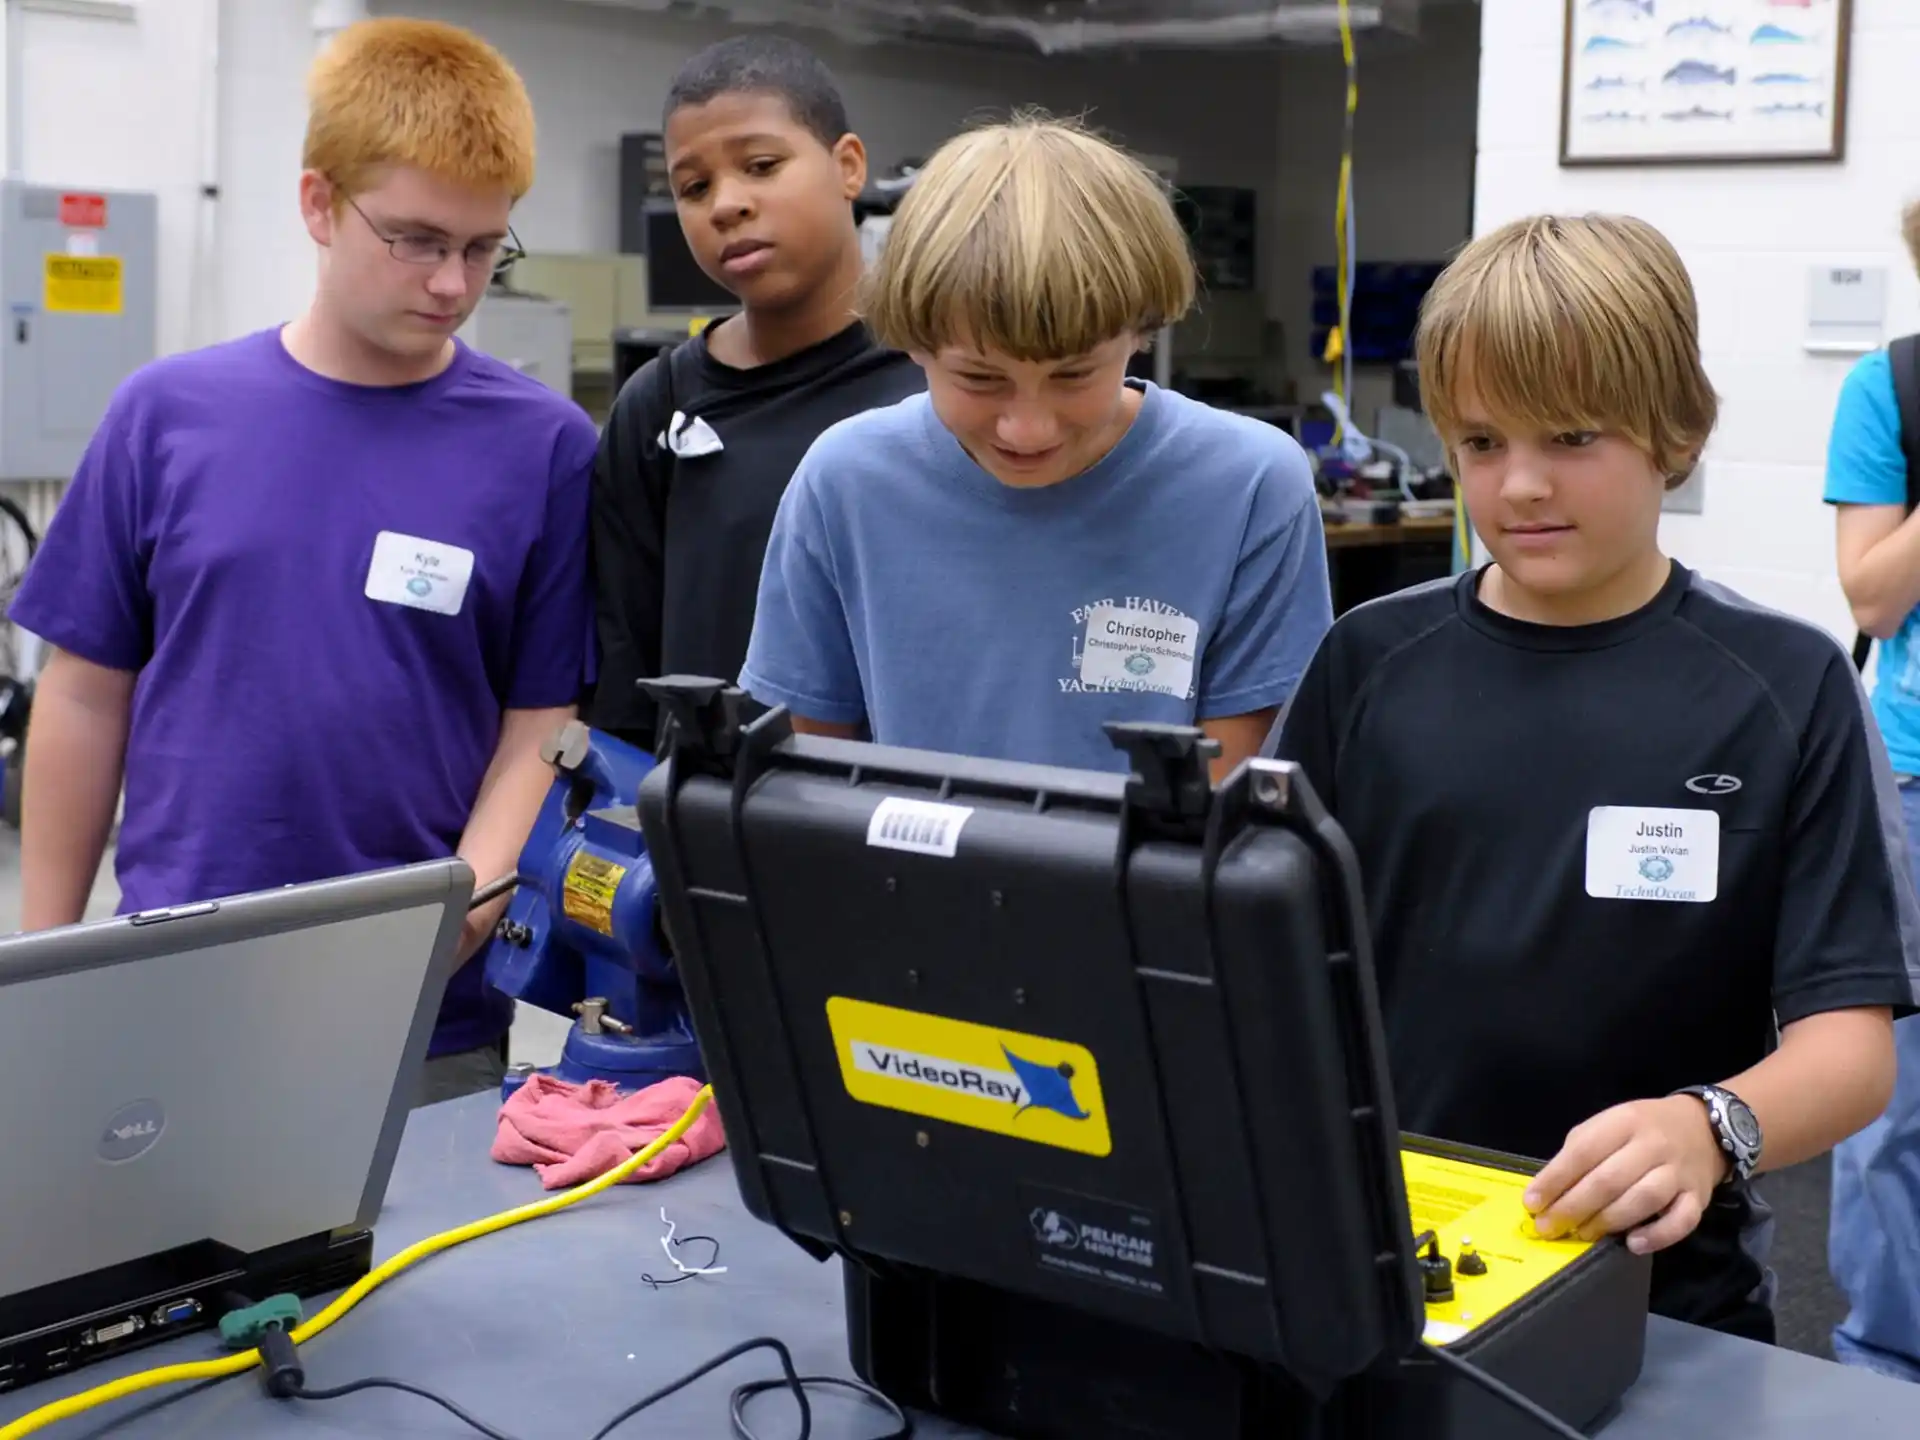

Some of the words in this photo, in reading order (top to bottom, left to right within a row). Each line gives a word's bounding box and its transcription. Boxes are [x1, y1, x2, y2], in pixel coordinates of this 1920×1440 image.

[1106, 620, 1187, 644] Christopher
[1088, 637, 1138, 652] Christopher
[1636, 821, 1683, 838] Justin
[1628, 844, 1658, 854] Justin
[1660, 845, 1689, 856] Vivian
[867, 1048, 1022, 1104] VideoRay
[1081, 1224, 1154, 1254] PELICAN
